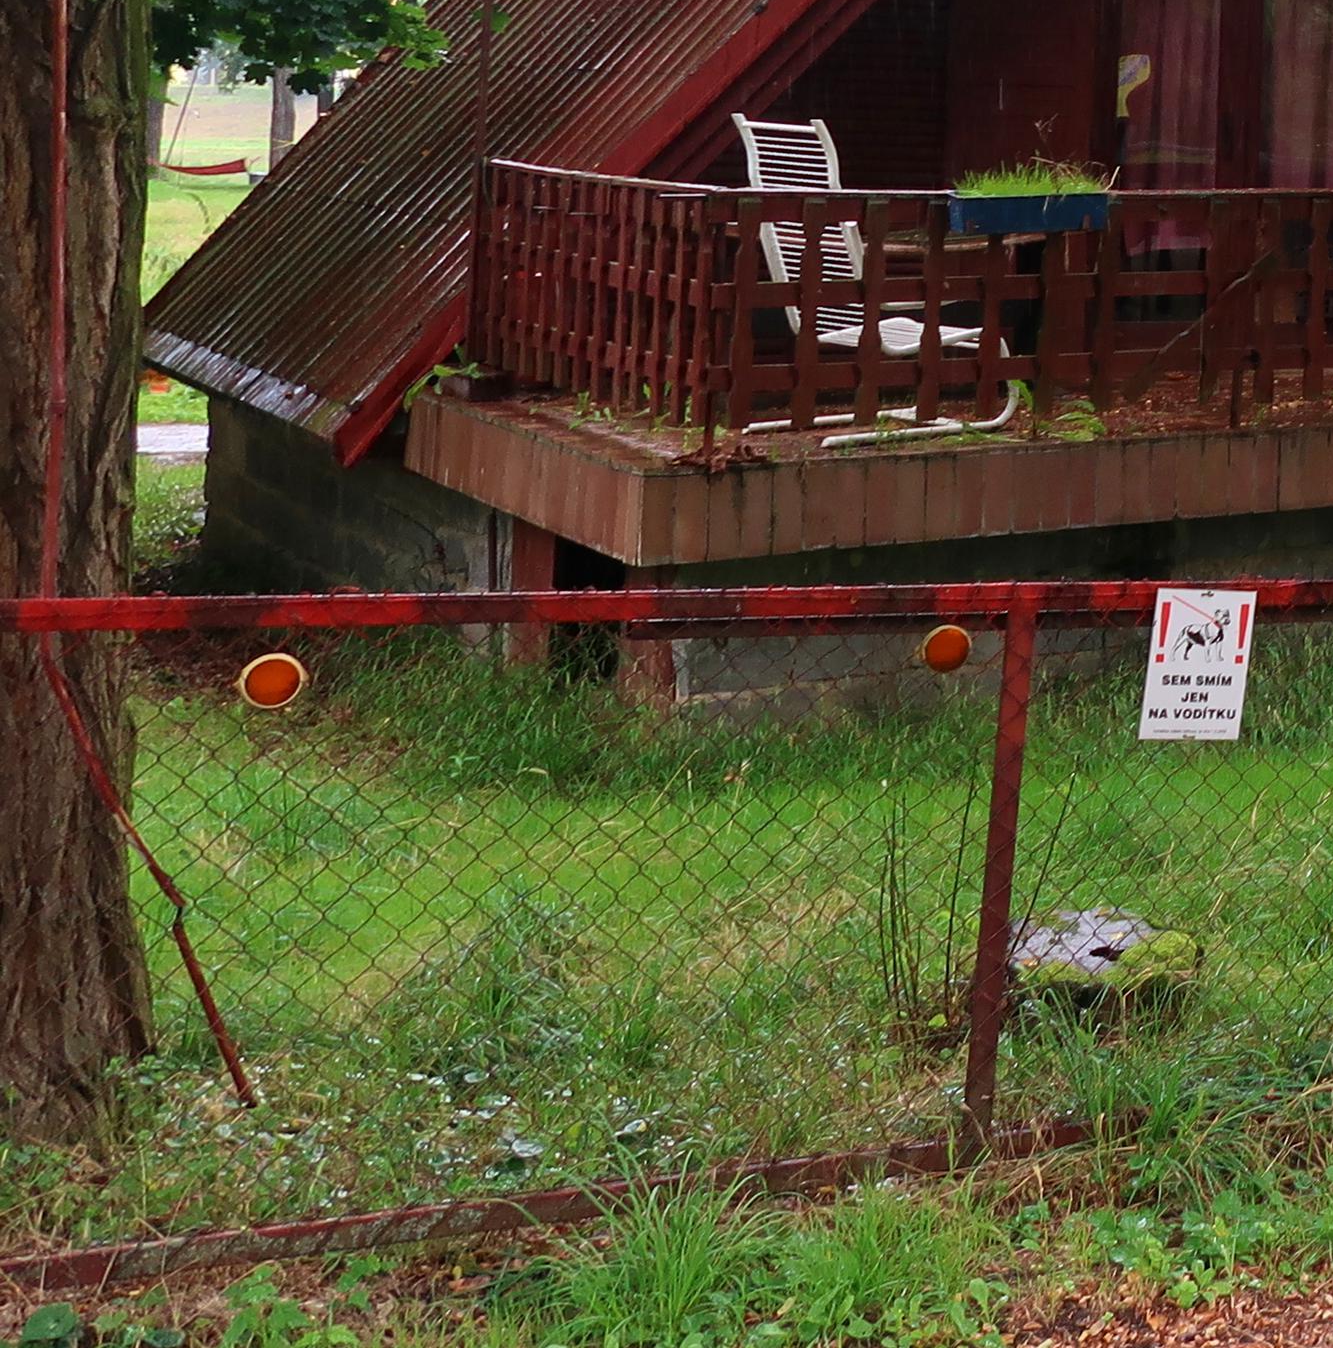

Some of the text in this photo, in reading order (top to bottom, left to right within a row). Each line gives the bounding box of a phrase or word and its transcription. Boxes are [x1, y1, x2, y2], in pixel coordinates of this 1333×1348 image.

[1162, 673, 1233, 686] SEM SMÍM
[1181, 692, 1209, 703] JEN
[1148, 707, 1236, 720] NA VODÍTKU
